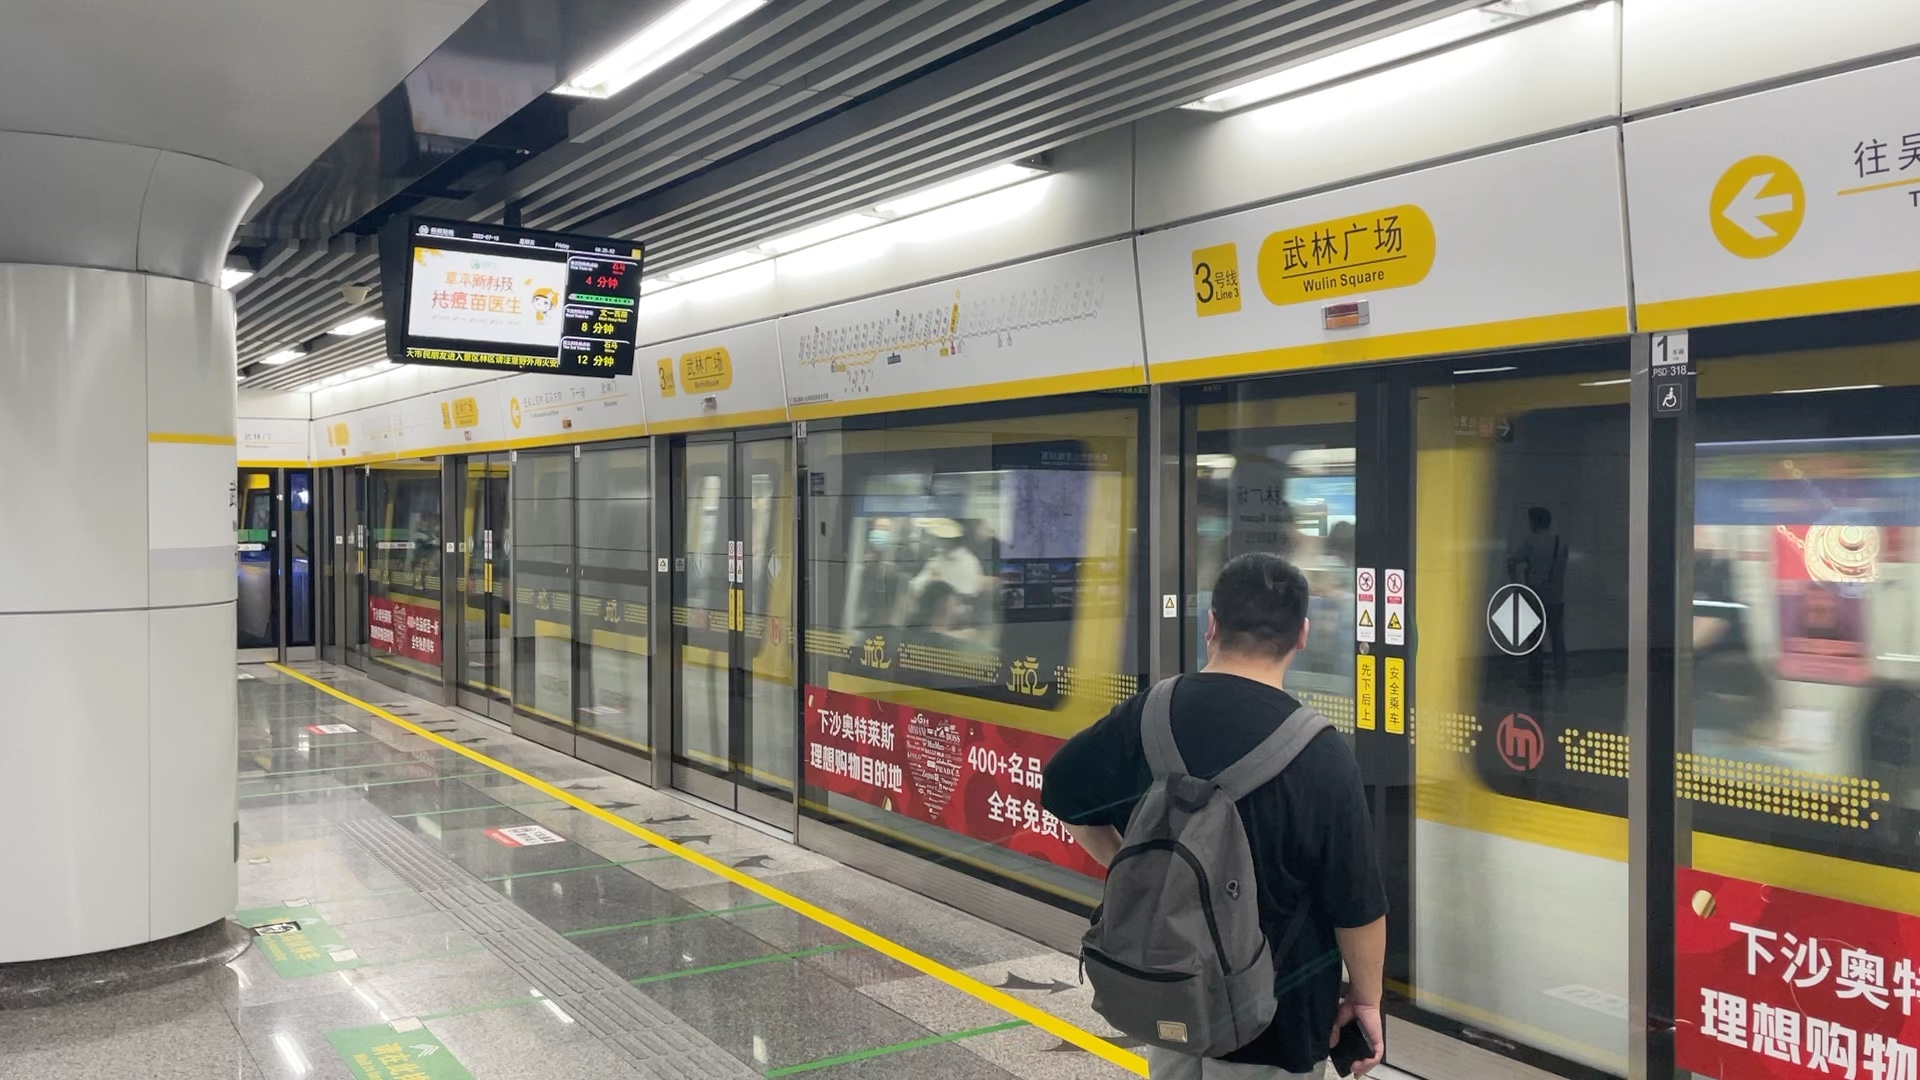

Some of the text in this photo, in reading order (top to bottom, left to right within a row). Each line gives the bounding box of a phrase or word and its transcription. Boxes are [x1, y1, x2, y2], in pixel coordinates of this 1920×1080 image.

[1282, 215, 1403, 272] 武林广场
[585, 276, 618, 289] 4 分钟
[1215, 290, 1233, 301] Line
[1303, 270, 1385, 293] Wulin Square
[581, 322, 614, 335] 8 分钟
[577, 355, 614, 367] 12 分钟
[1657, 335, 1668, 361] 1
[1653, 365, 1687, 377] PSD 318
[1361, 664, 1372, 722] 先下后上
[1389, 667, 1400, 725] 安全乘车
[817, 709, 895, 752] 下沙奥特莱斯
[810, 742, 903, 794] 理想购物目的地
[1729, 921, 1920, 1016] 下沙奥特
[1700, 987, 1919, 1080] 理想购物
